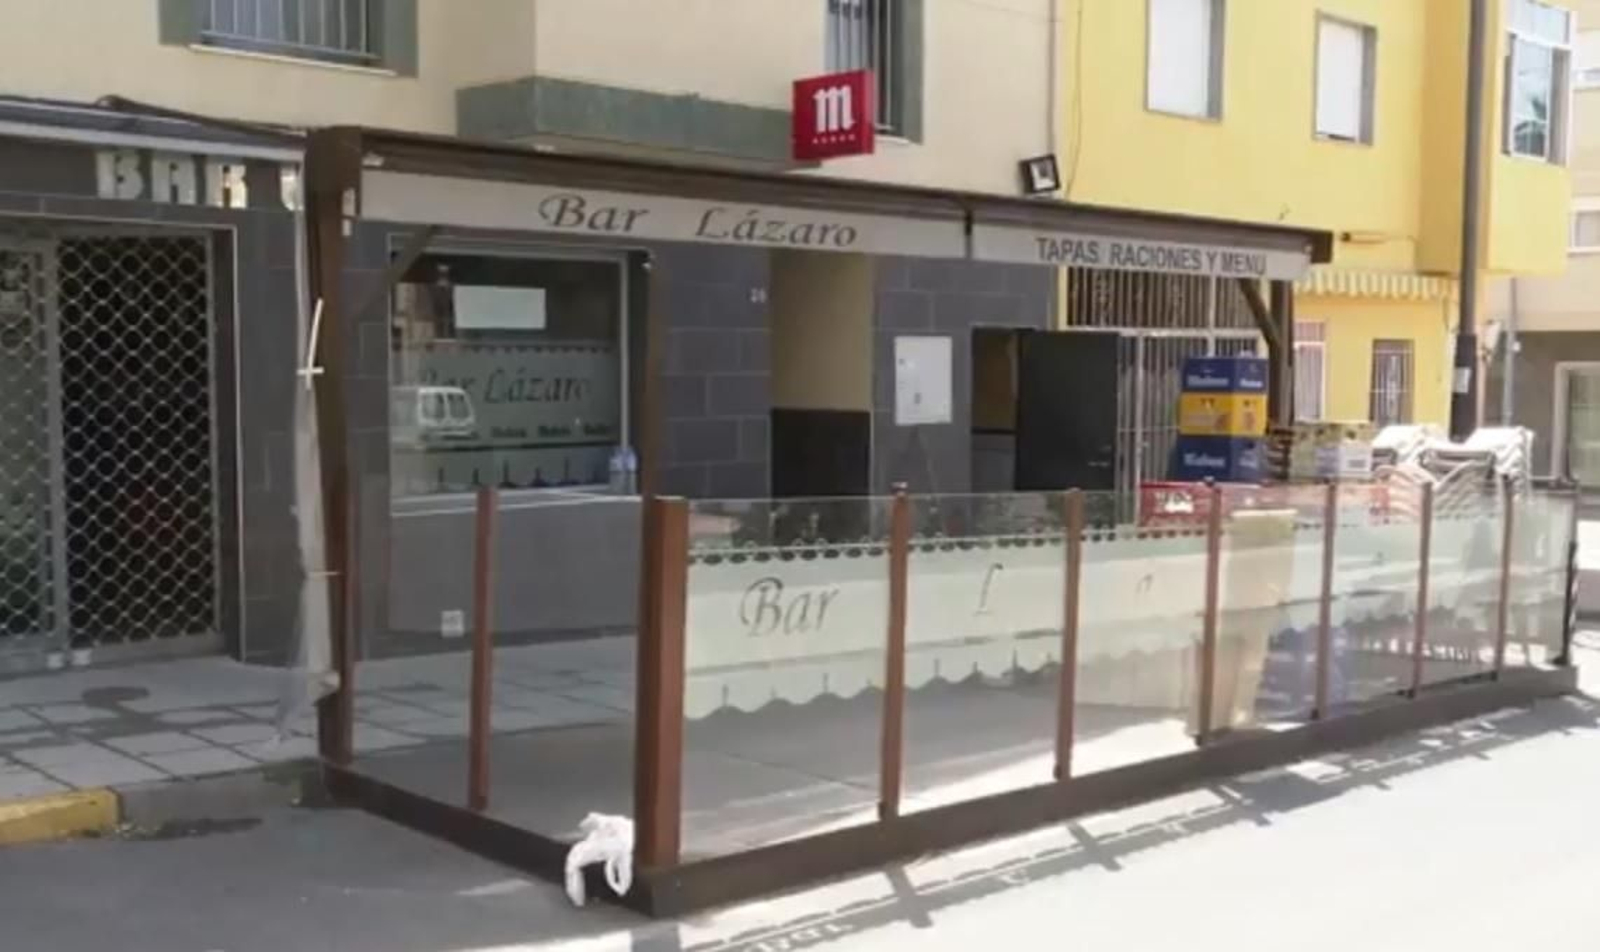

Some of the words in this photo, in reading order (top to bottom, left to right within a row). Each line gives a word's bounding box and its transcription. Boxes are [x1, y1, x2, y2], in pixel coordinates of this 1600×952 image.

[96, 150, 248, 208] BAR
[538, 193, 648, 232] Bar
[695, 207, 857, 248] Lázaro
[1109, 249, 1202, 270] RACIONES
[1206, 252, 1219, 273] Y
[739, 576, 838, 637] Bar
